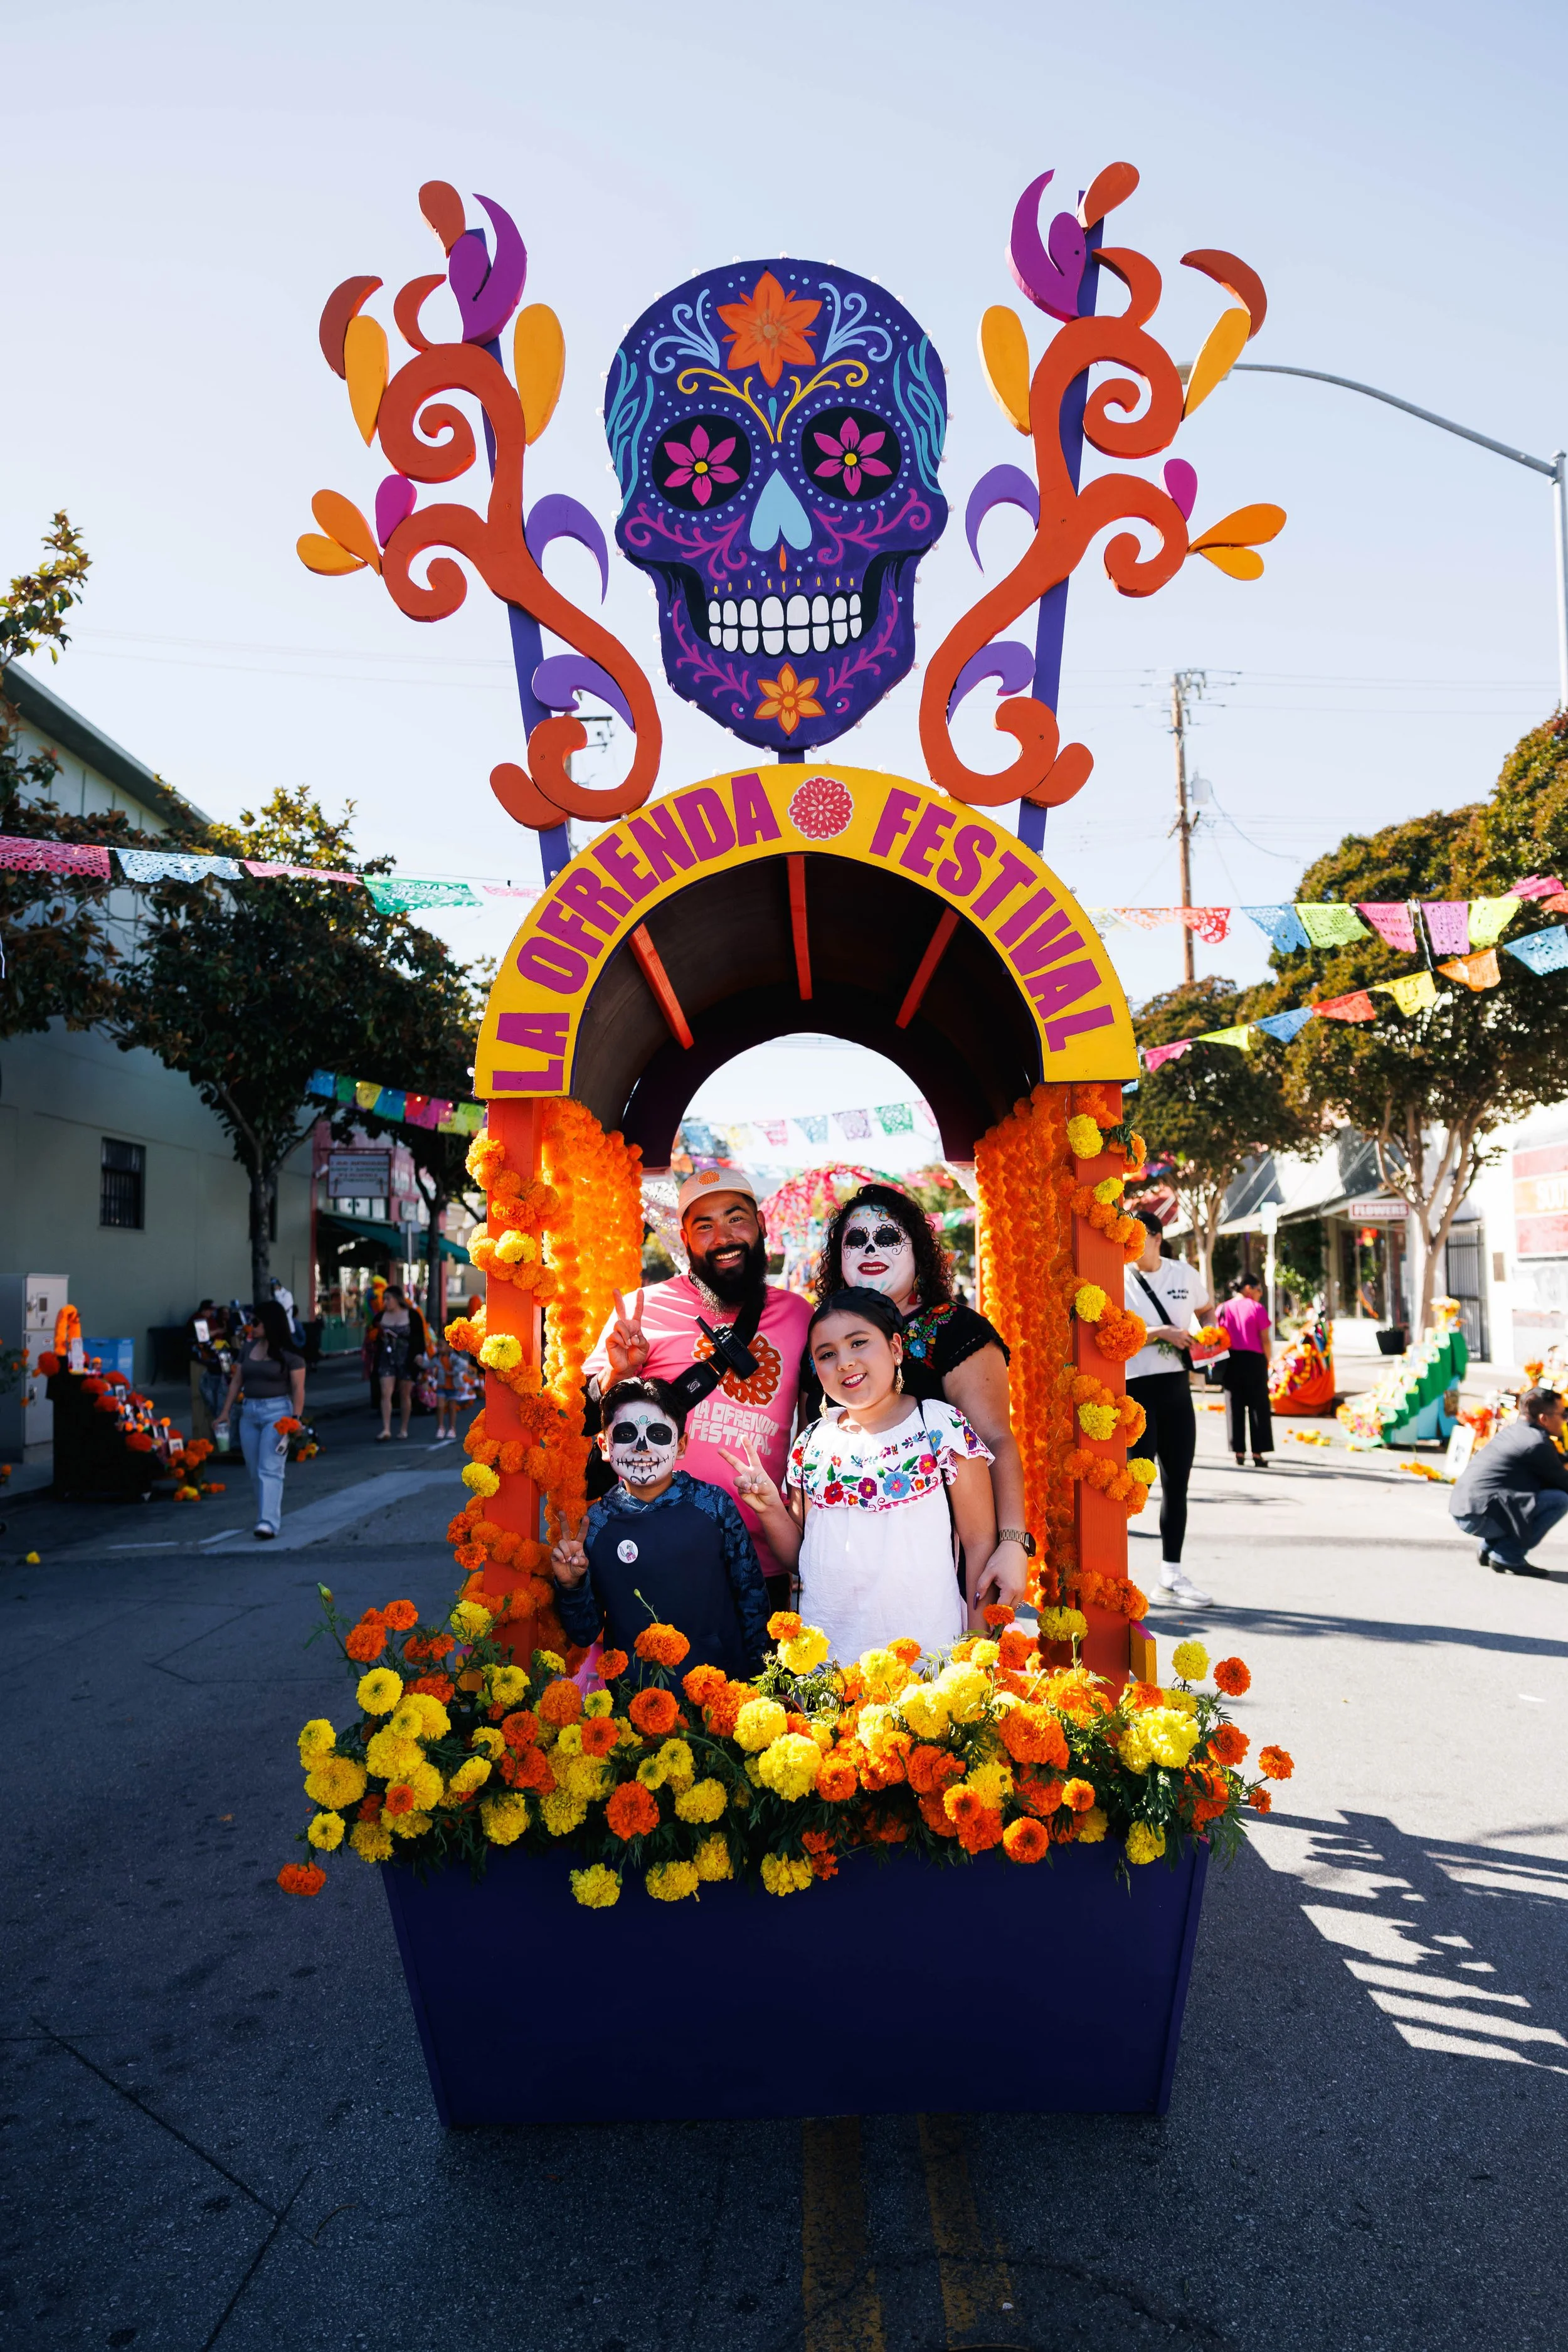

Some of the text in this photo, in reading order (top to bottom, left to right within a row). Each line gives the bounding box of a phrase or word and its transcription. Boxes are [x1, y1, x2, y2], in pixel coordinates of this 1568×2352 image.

[494, 775, 1113, 1089] LA OFRENDA FESTIVAL
[1354, 1204, 1407, 1216] FLOWERS
[694, 1400, 780, 1436] LA OFRENDA
